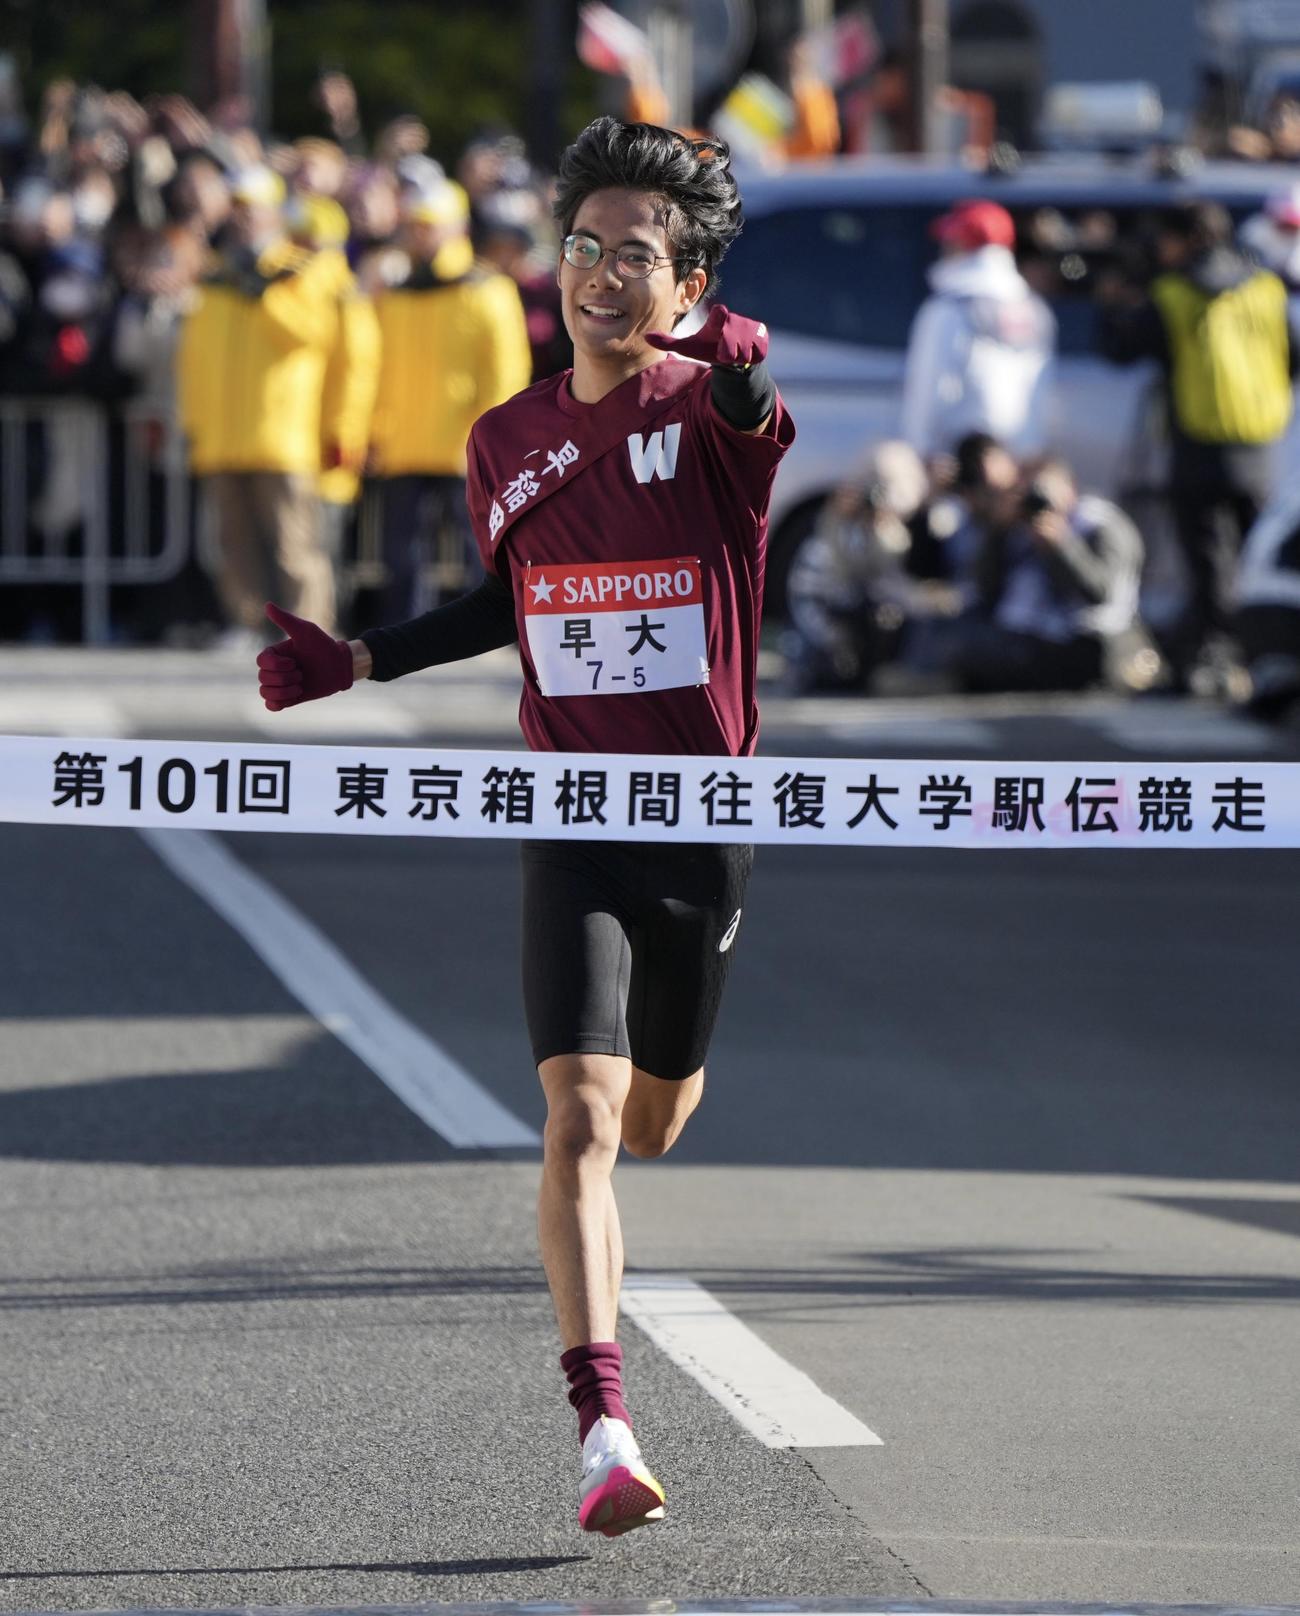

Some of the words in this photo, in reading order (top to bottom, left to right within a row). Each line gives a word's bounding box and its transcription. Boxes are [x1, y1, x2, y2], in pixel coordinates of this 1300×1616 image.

[627, 422, 682, 484] W
[488, 439, 580, 541] 早稲田
[563, 569, 693, 604] SAPPORO
[52, 751, 291, 815] 第101回
[335, 762, 1266, 833] 東京箱根間往復大学駅伝競走
